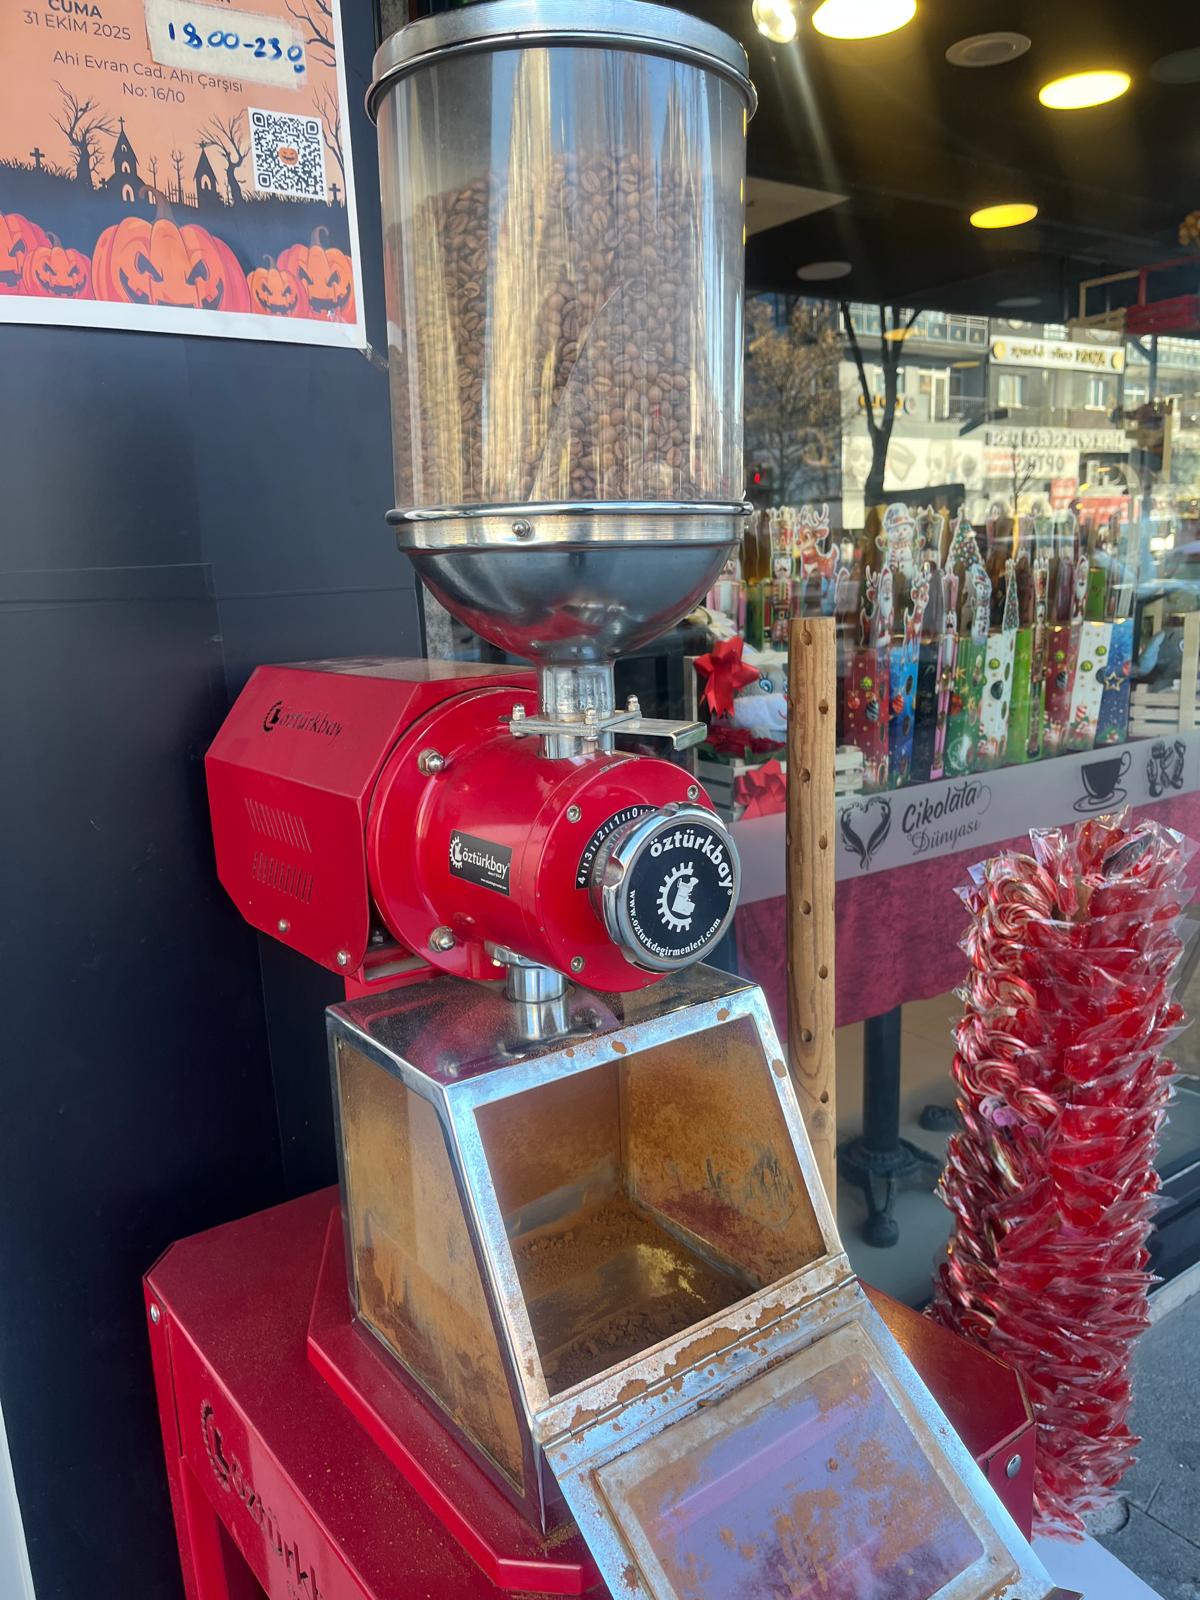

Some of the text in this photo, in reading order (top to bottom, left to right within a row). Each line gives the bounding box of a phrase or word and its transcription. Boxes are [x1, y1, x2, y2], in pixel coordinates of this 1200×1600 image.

[23, 10, 131, 41] 31 EKİM 2025
[48, 0, 103, 19] CUMA
[53, 50, 243, 93] Ahi Evran Cad. Ahi Çarşısı
[122, 82, 186, 104] No: 16/10
[577, 807, 638, 885] 4 3 2 1 0
[628, 889, 721, 958] www.ozturkdegirmenleri.com
